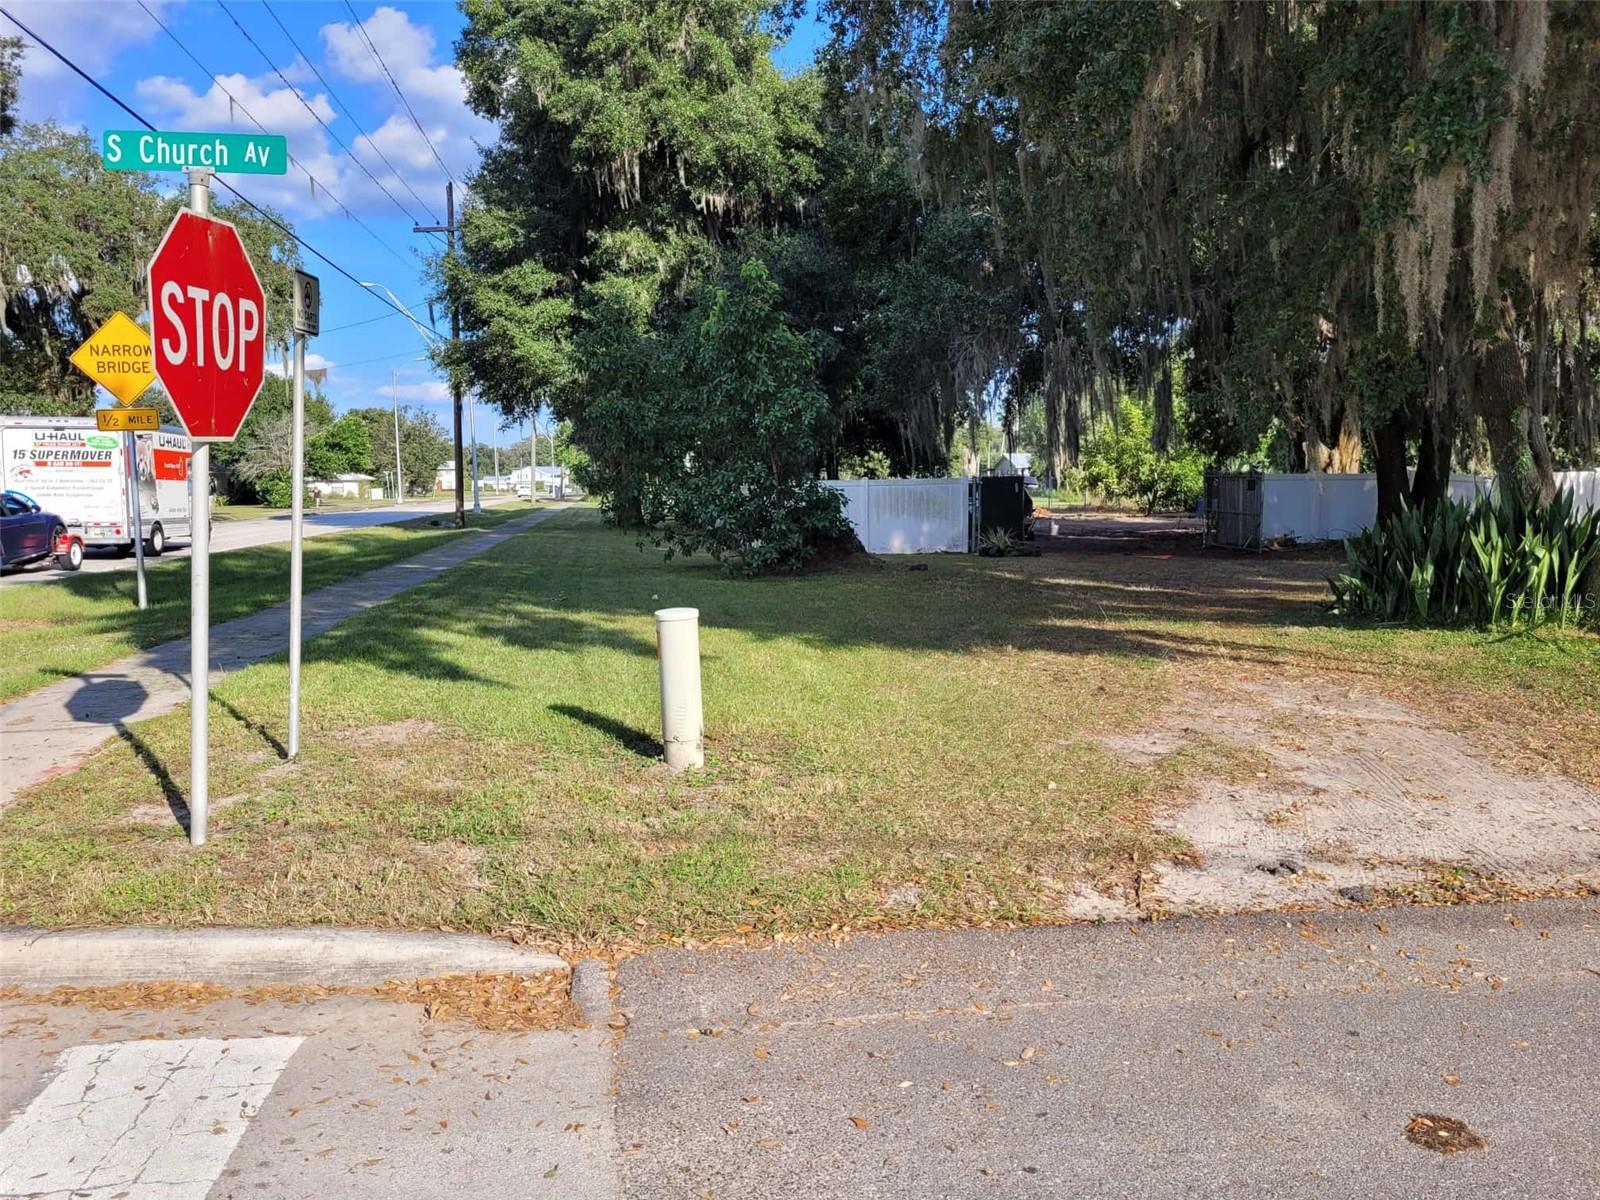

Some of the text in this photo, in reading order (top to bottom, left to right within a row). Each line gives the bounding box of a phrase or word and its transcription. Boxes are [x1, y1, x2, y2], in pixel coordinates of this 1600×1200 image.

[106, 134, 122, 163] S
[139, 135, 228, 166] Church
[161, 280, 259, 372] STOP
[97, 361, 151, 373] BRIDGE
[103, 414, 153, 427] 1/2 MILE
[29, 449, 113, 460] SUPERMOVER
